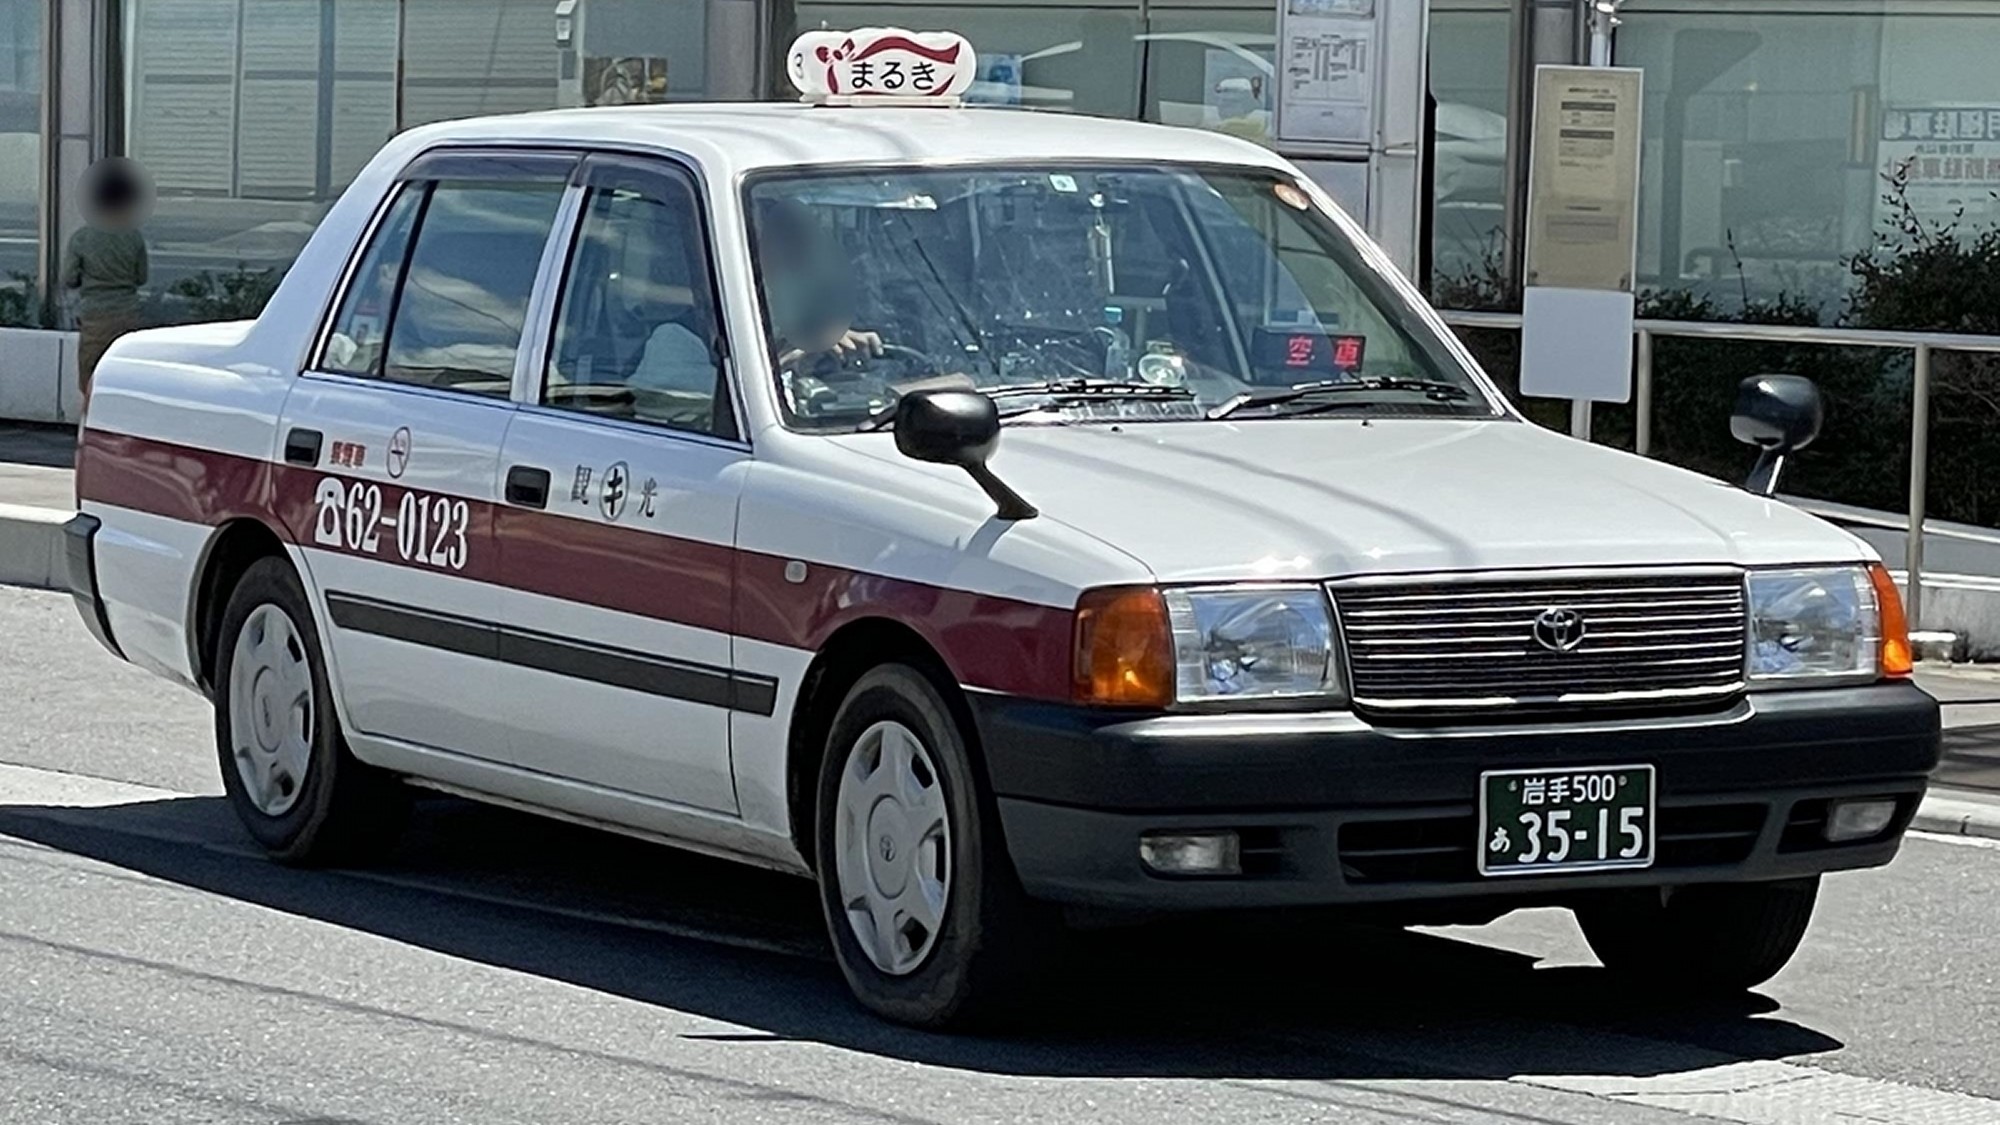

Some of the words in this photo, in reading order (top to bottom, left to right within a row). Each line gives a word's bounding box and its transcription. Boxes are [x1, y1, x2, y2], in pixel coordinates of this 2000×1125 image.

[851, 61, 936, 91] まるき
[1285, 335, 1360, 367] 空車
[344, 481, 469, 570] 62-0123
[1521, 774, 1617, 805] 岩手500
[1489, 826, 1511, 853] あ
[1517, 806, 1644, 863] 35-15
